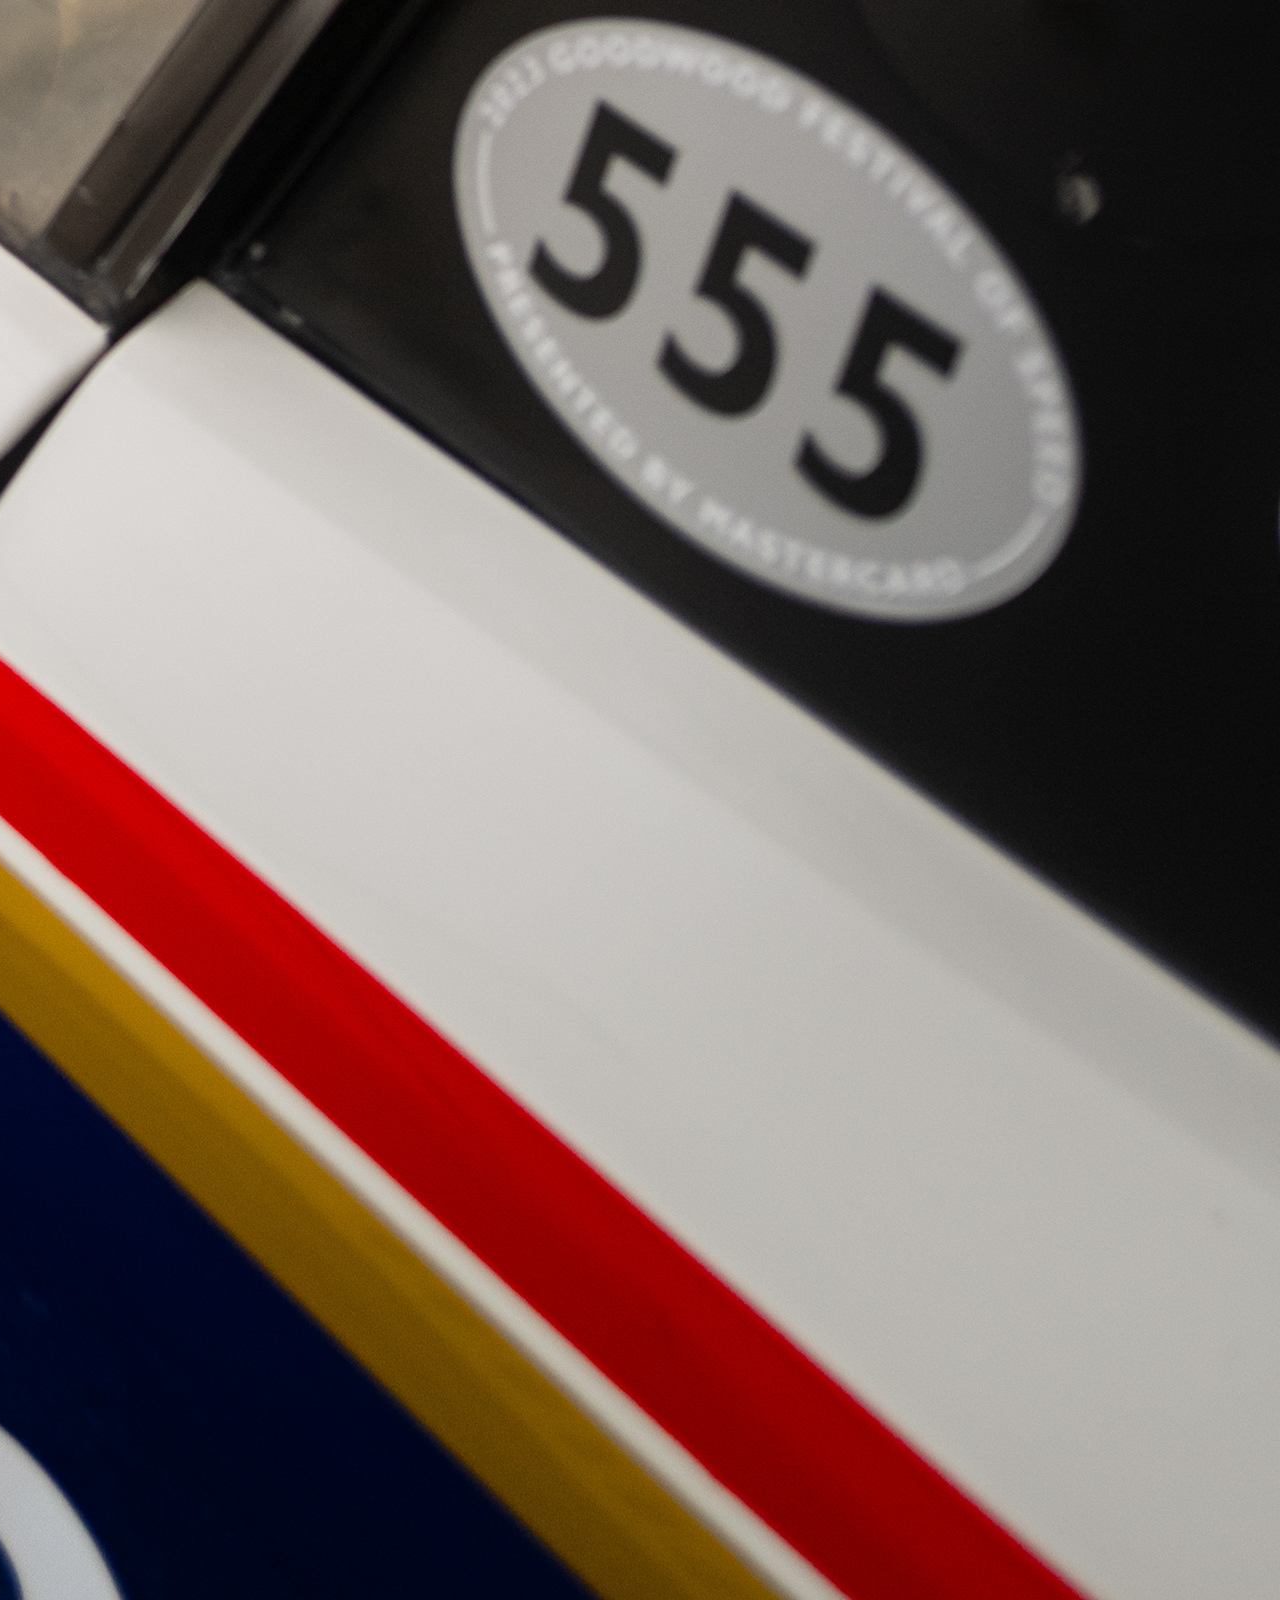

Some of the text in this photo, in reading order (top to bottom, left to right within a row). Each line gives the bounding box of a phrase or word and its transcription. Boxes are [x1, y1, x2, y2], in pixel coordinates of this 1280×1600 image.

[487, 240, 971, 598] PRESENTED BY MASTERCARD
[527, 95, 966, 526] 555
[545, 32, 793, 115] GOODWOOD
[797, 98, 978, 270] FESTIVAL
[972, 268, 1030, 337] OF
[1014, 344, 1073, 508] SPEED
